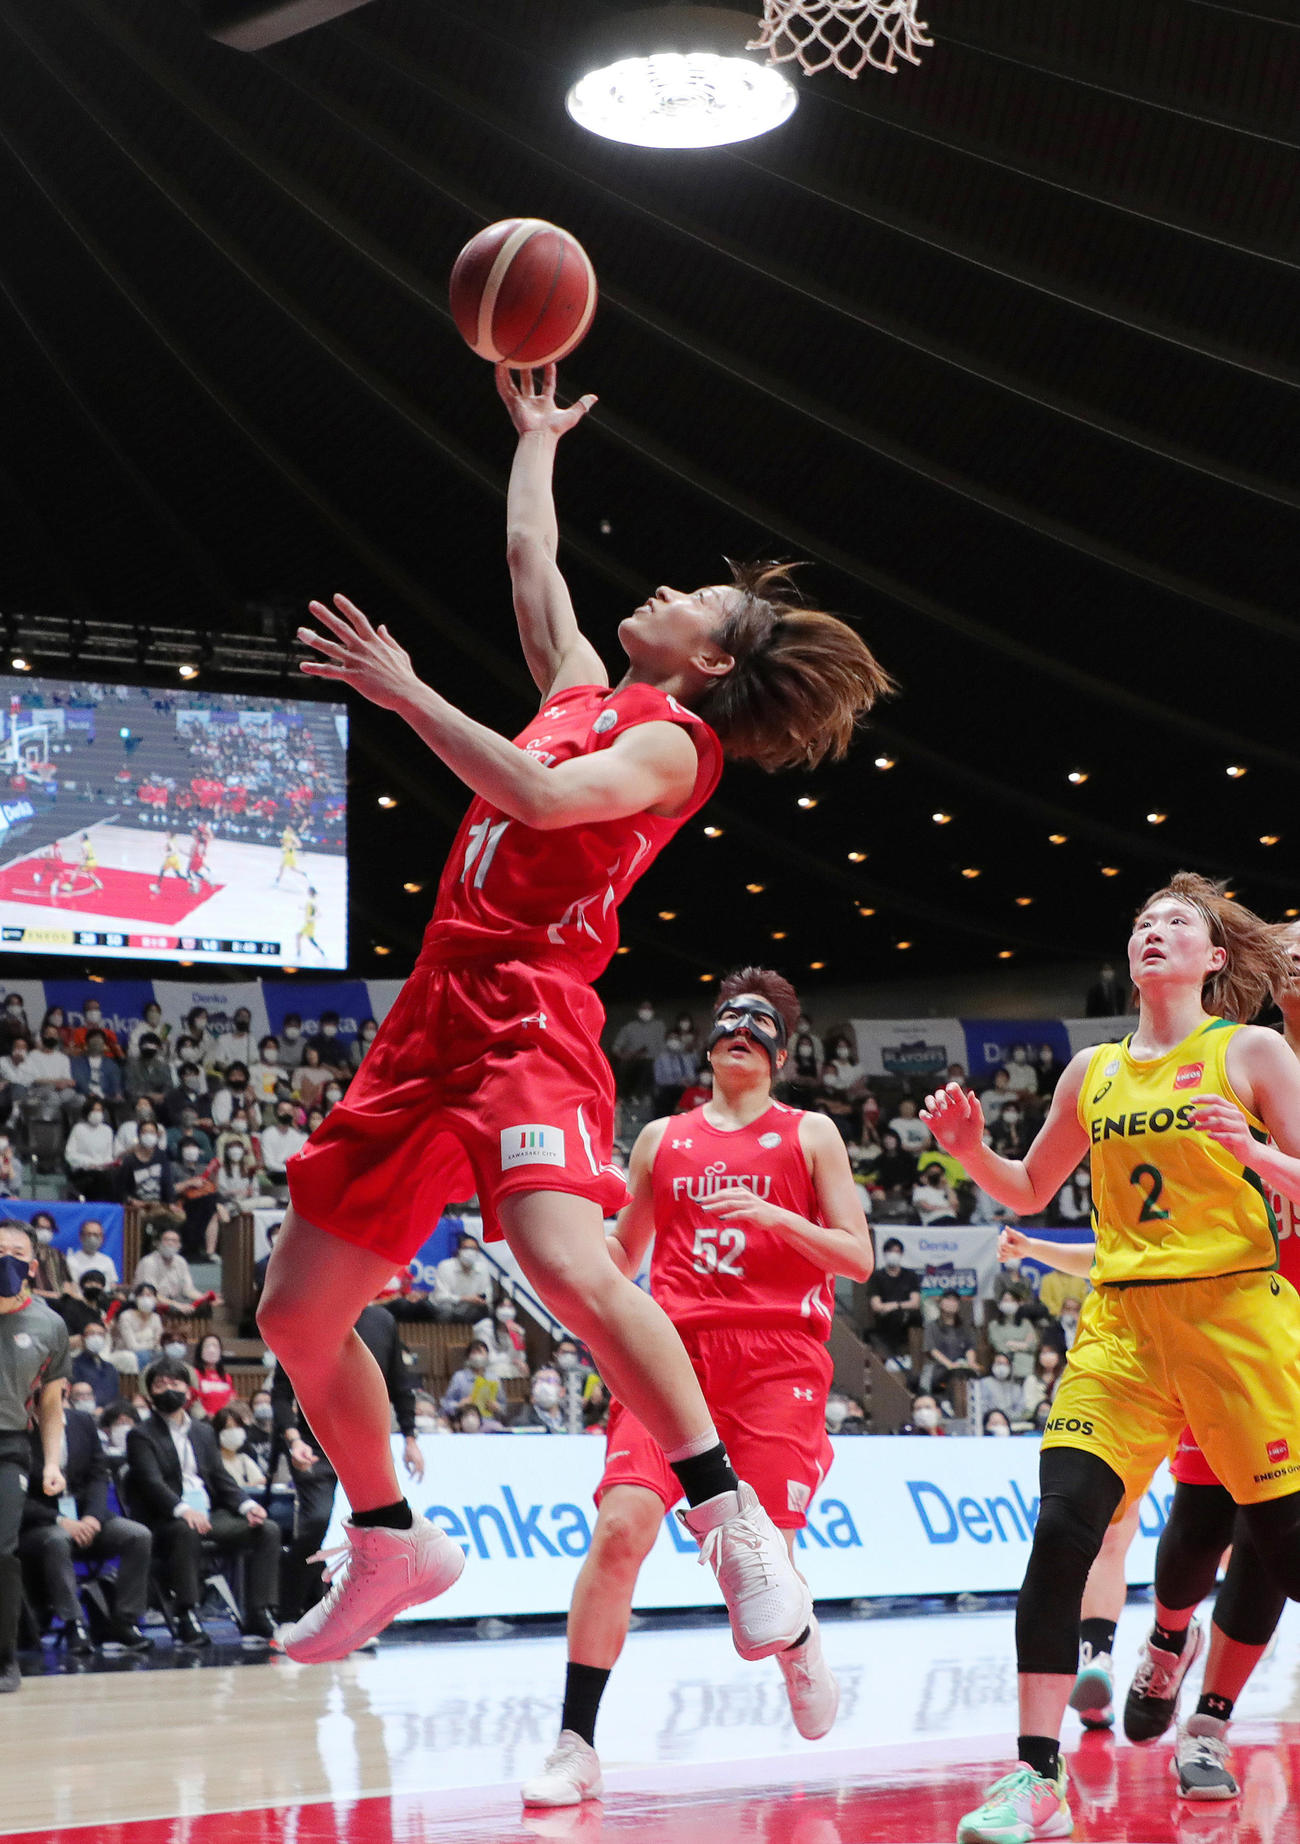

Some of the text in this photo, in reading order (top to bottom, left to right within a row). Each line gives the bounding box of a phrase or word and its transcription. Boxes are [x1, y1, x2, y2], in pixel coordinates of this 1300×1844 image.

[460, 818, 510, 889] 11
[1176, 1070, 1201, 1081] ENEOS
[1091, 1105, 1198, 1145] ENEOS
[1129, 1163, 1170, 1223] 2
[692, 1228, 747, 1277] 52
[1046, 1418, 1094, 1436] NEOS
[1254, 1468, 1287, 1483] ENEOS
[423, 1485, 593, 1559] enka
